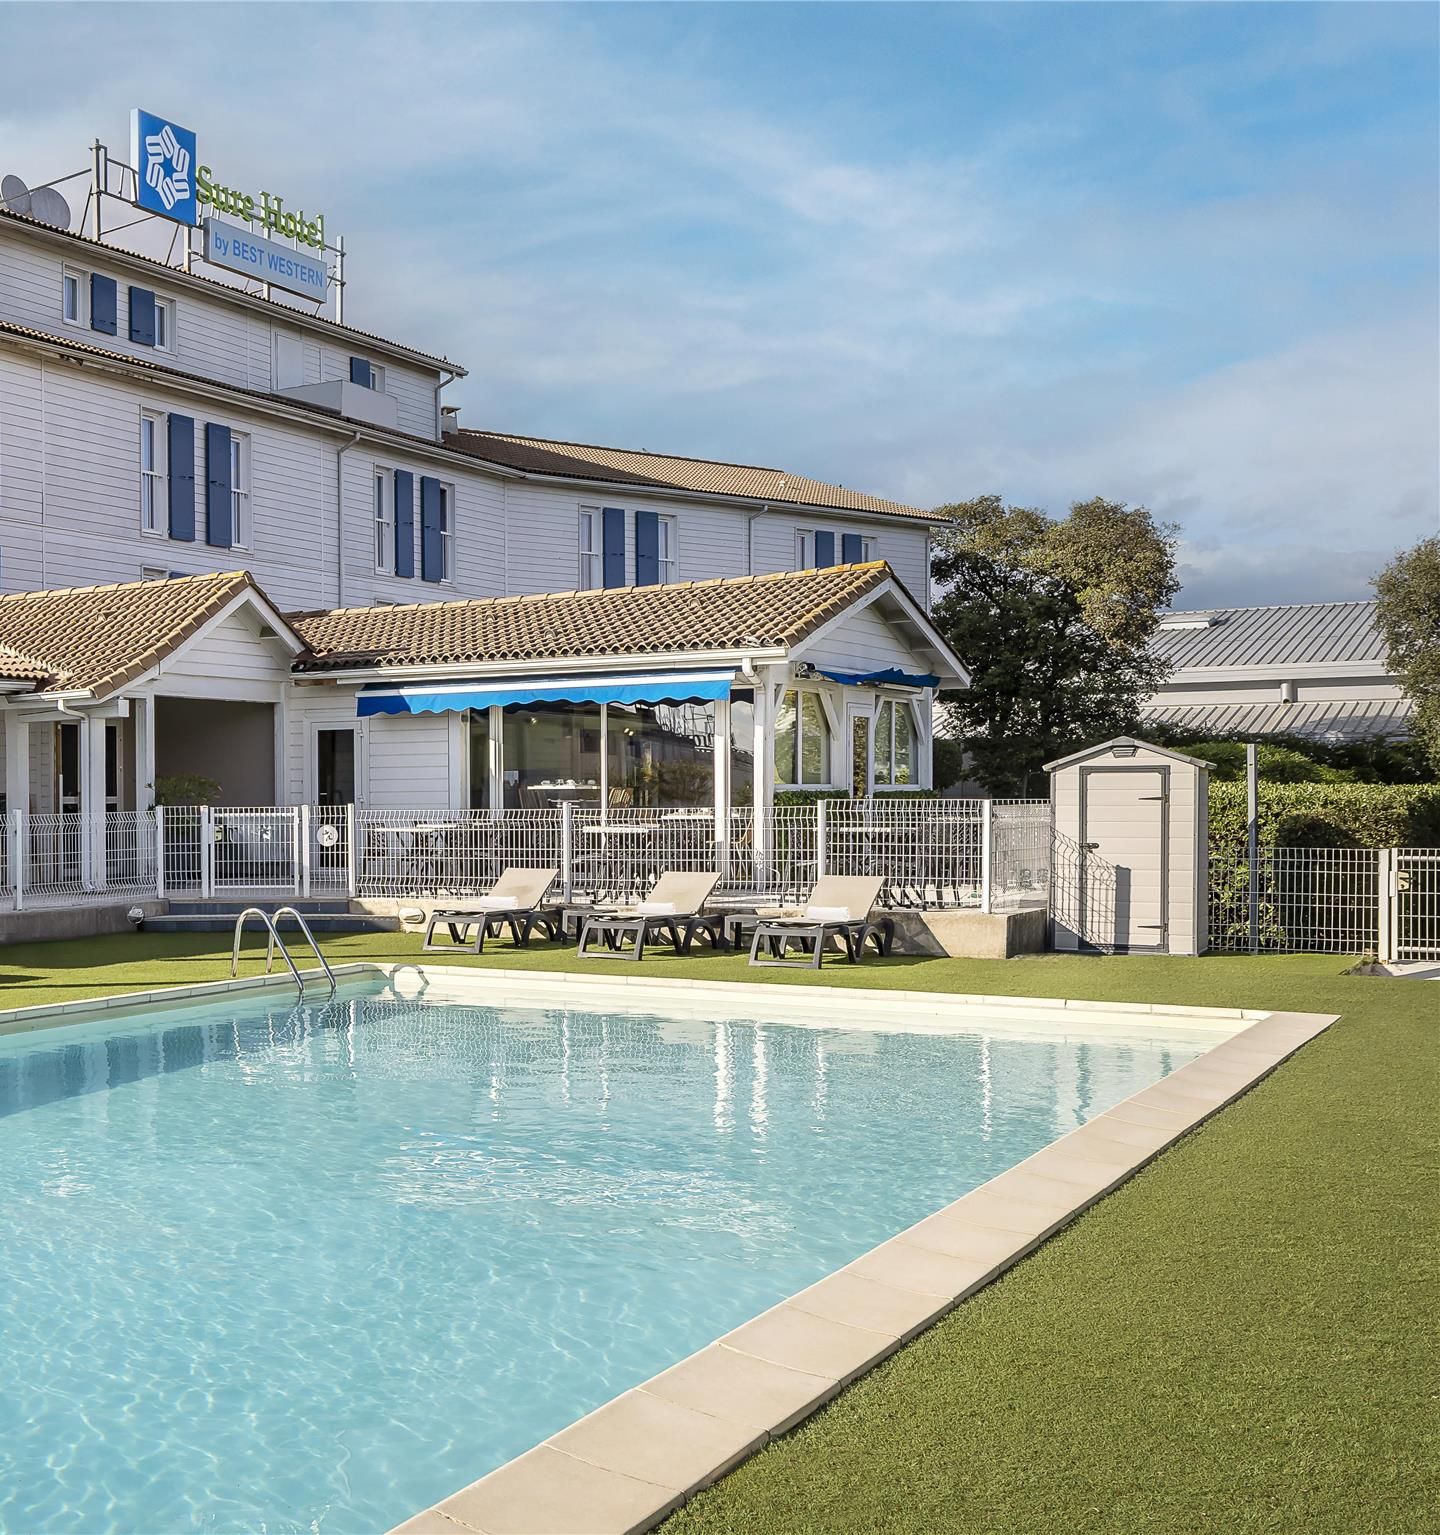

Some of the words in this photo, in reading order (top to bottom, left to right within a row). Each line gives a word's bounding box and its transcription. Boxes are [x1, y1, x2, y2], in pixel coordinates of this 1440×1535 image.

[195, 165, 255, 222] Sure
[259, 190, 326, 250] Hotel
[214, 231, 229, 256] by
[232, 239, 265, 266] BEST
[267, 252, 323, 287] WESTERN
